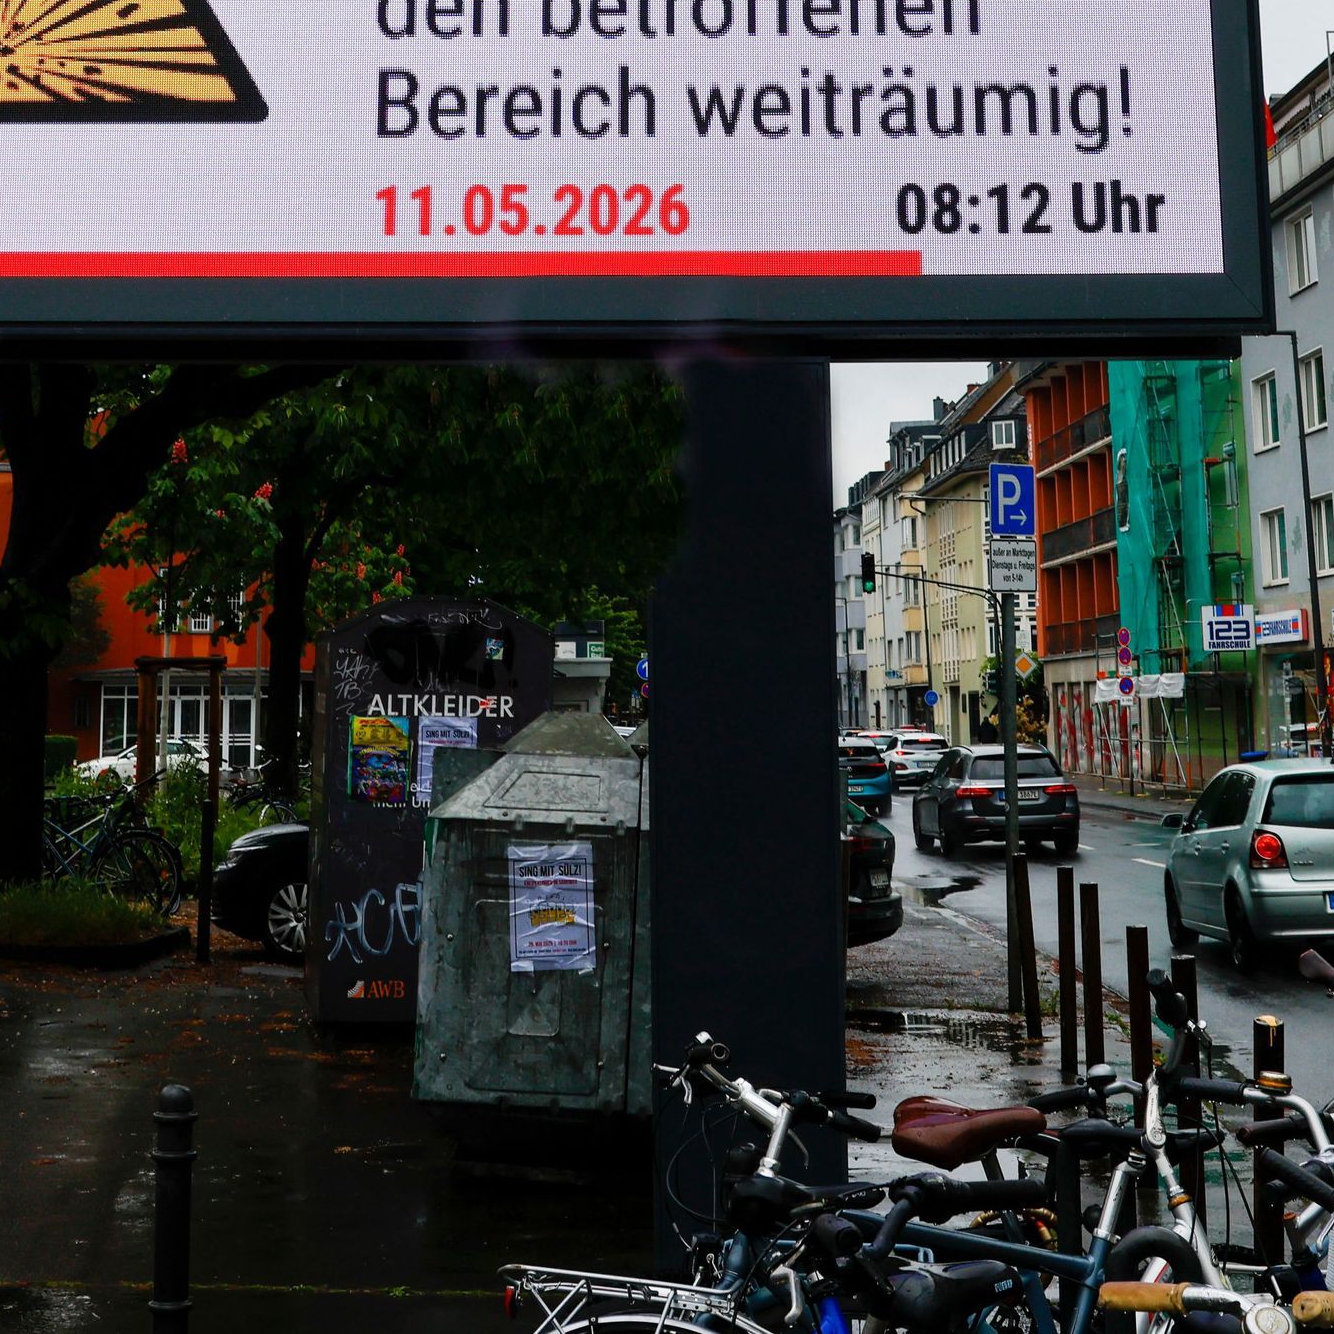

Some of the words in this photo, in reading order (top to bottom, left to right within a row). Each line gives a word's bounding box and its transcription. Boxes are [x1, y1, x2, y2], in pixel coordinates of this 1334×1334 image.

[376, 64, 656, 140] Bereich
[686, 65, 1132, 155] weiträumig!
[376, 183, 690, 236] 11.05.2026
[896, 181, 1053, 236] 08:12
[1071, 178, 1166, 234] Uhr
[998, 473, 1021, 525] P
[992, 560, 1013, 571] Dienstags
[1019, 561, 1035, 571] Freitags
[1207, 620, 1250, 641] 123
[1209, 640, 1251, 649] FAHRSCHULE
[367, 693, 515, 718] ALTKLEIDER
[425, 730, 439, 739] SING
[440, 729, 451, 738] MIT
[519, 865, 538, 878] SING
[540, 865, 555, 877] MIT
[558, 863, 582, 877] SÜLZ!
[367, 980, 405, 999] AWB
